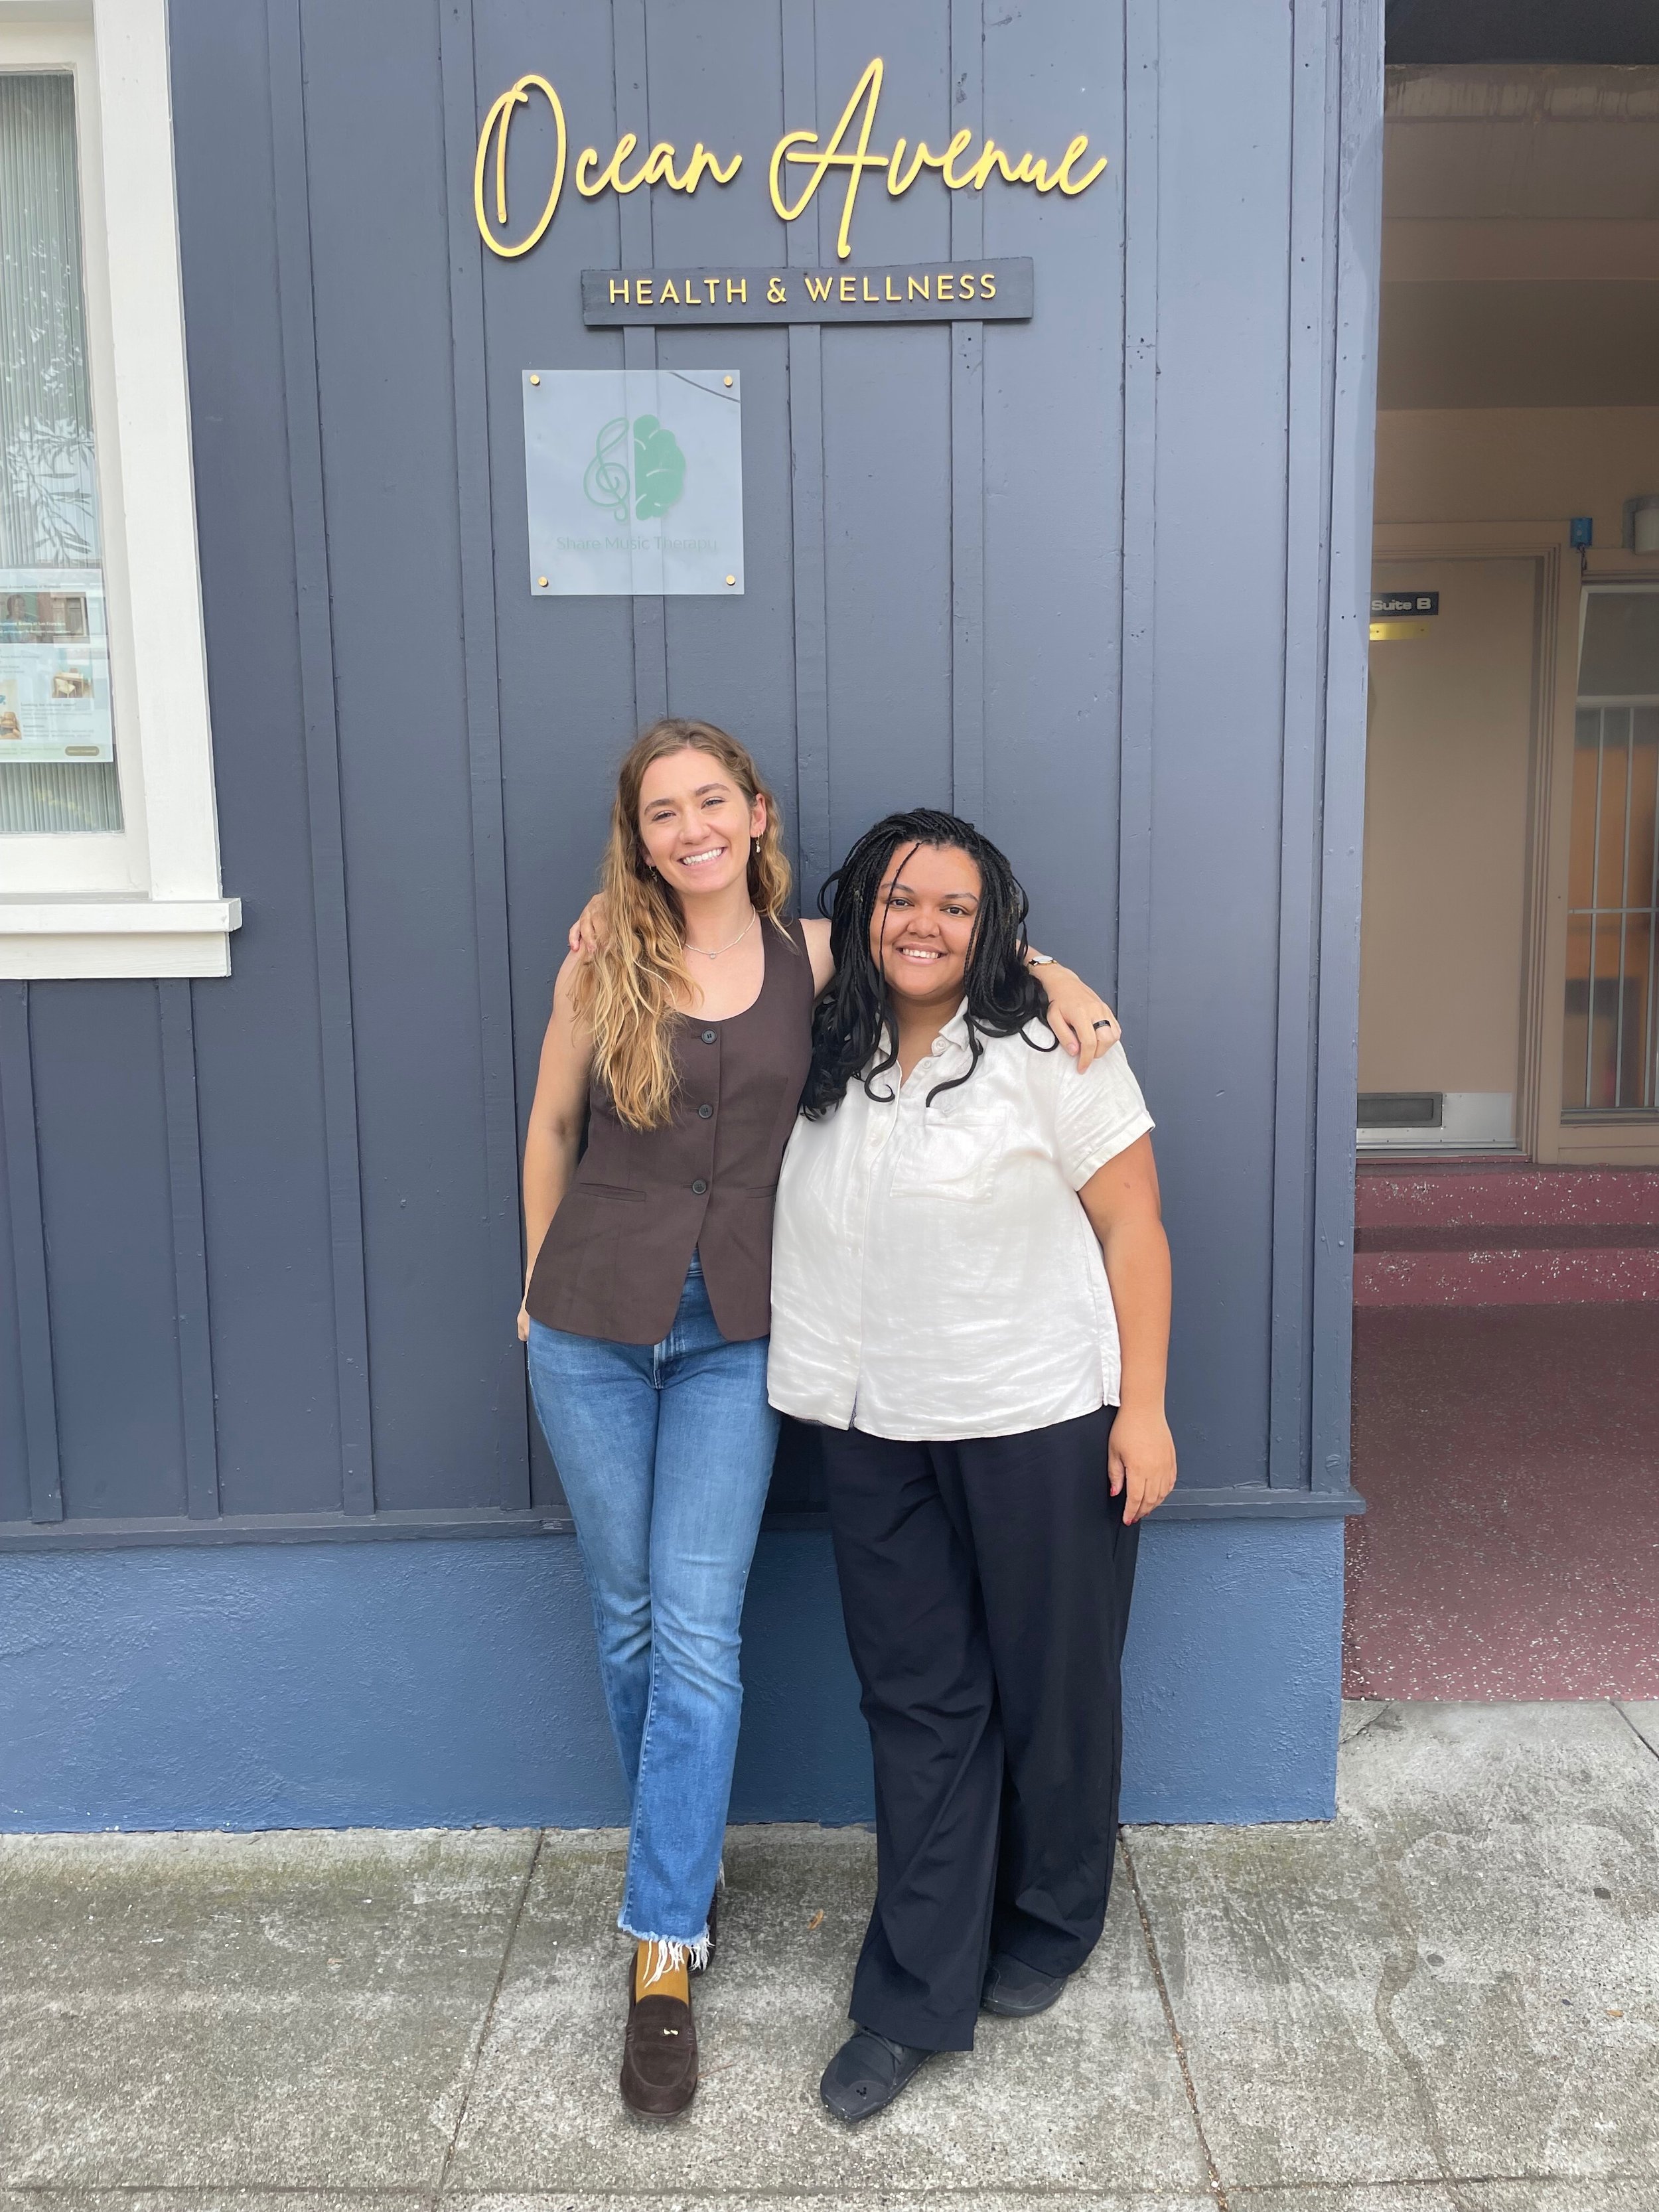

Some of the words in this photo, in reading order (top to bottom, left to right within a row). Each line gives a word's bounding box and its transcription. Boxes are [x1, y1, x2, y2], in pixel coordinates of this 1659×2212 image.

[474, 74, 742, 258] Ocean
[769, 58, 1108, 258] Avenue
[609, 279, 747, 305] HEALTH
[766, 277, 786, 303] &
[806, 273, 997, 301] WELLNESS
[556, 536, 601, 551] Share
[605, 536, 650, 550] Music
[653, 536, 717, 552] Therapy
[1371, 599, 1412, 611] Suite
[1416, 597, 1431, 610] B
